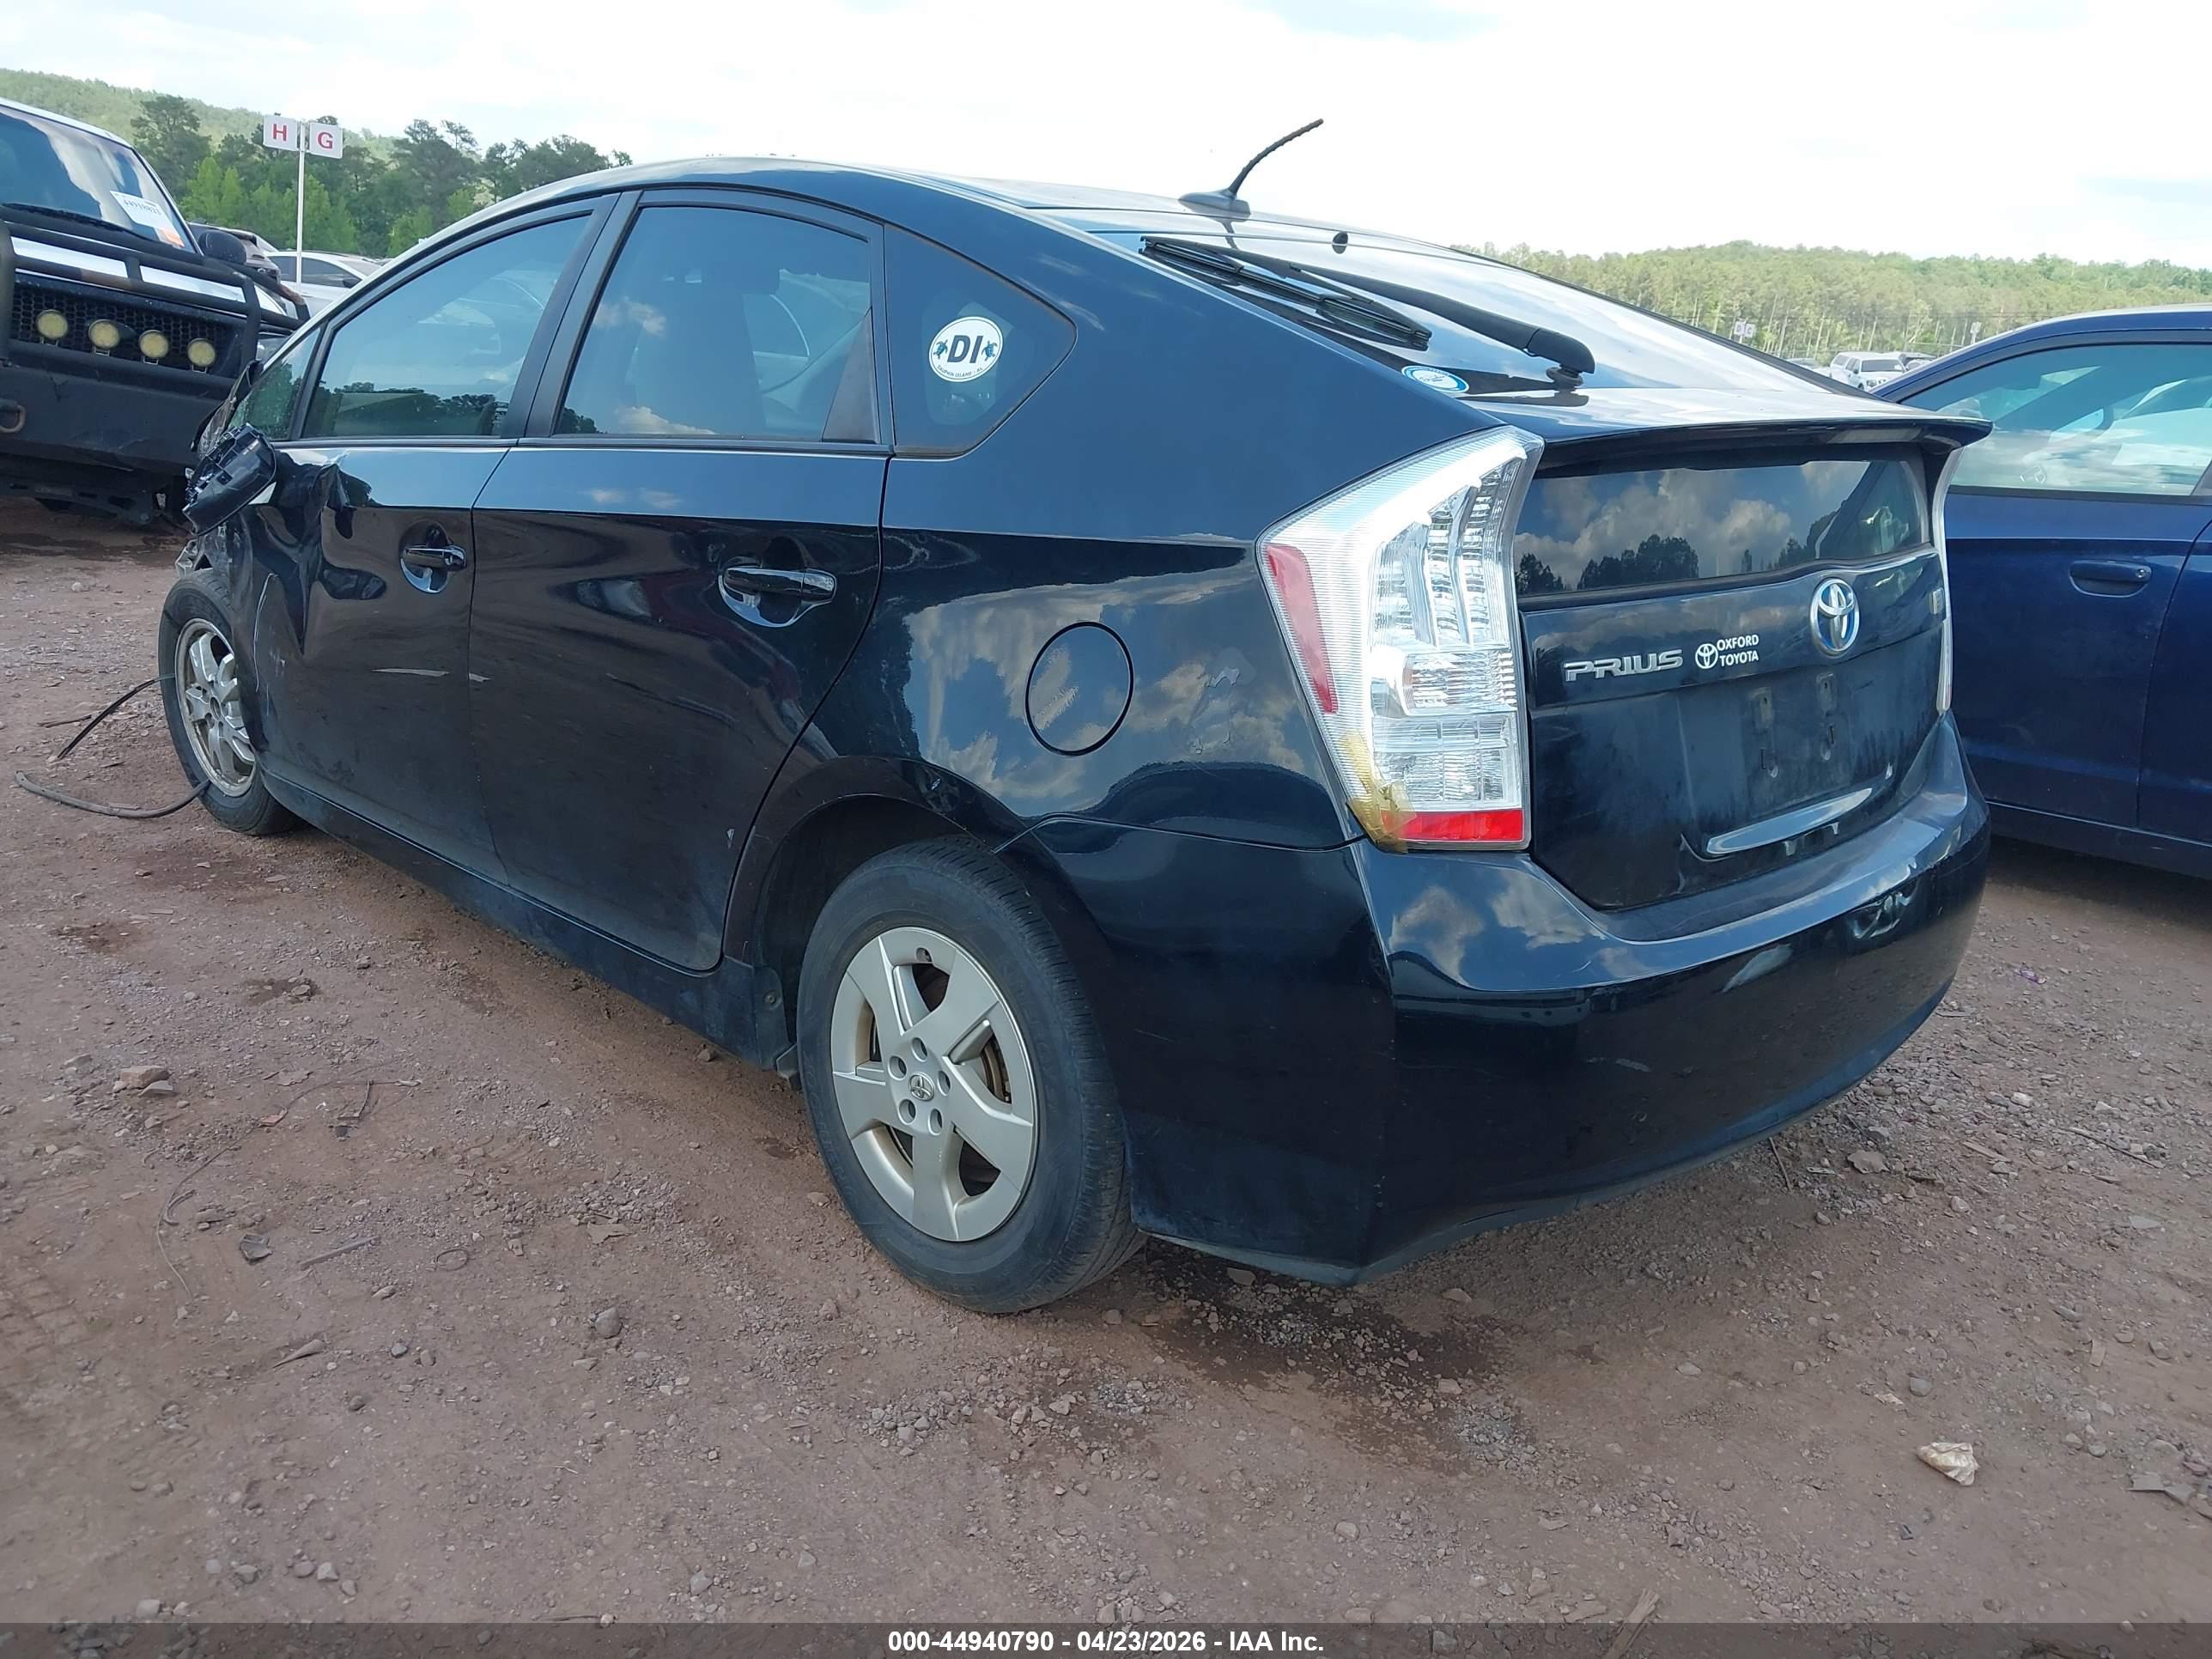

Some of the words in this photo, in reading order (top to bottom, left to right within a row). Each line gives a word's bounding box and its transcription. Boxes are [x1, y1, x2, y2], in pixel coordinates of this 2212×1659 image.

[272, 123, 288, 142] H
[317, 131, 334, 149] G
[947, 335, 983, 363] DI
[1717, 634, 1759, 652] OXFORD
[1563, 648, 1684, 682] PRIUS
[1719, 649, 1759, 667] TOYOTA
